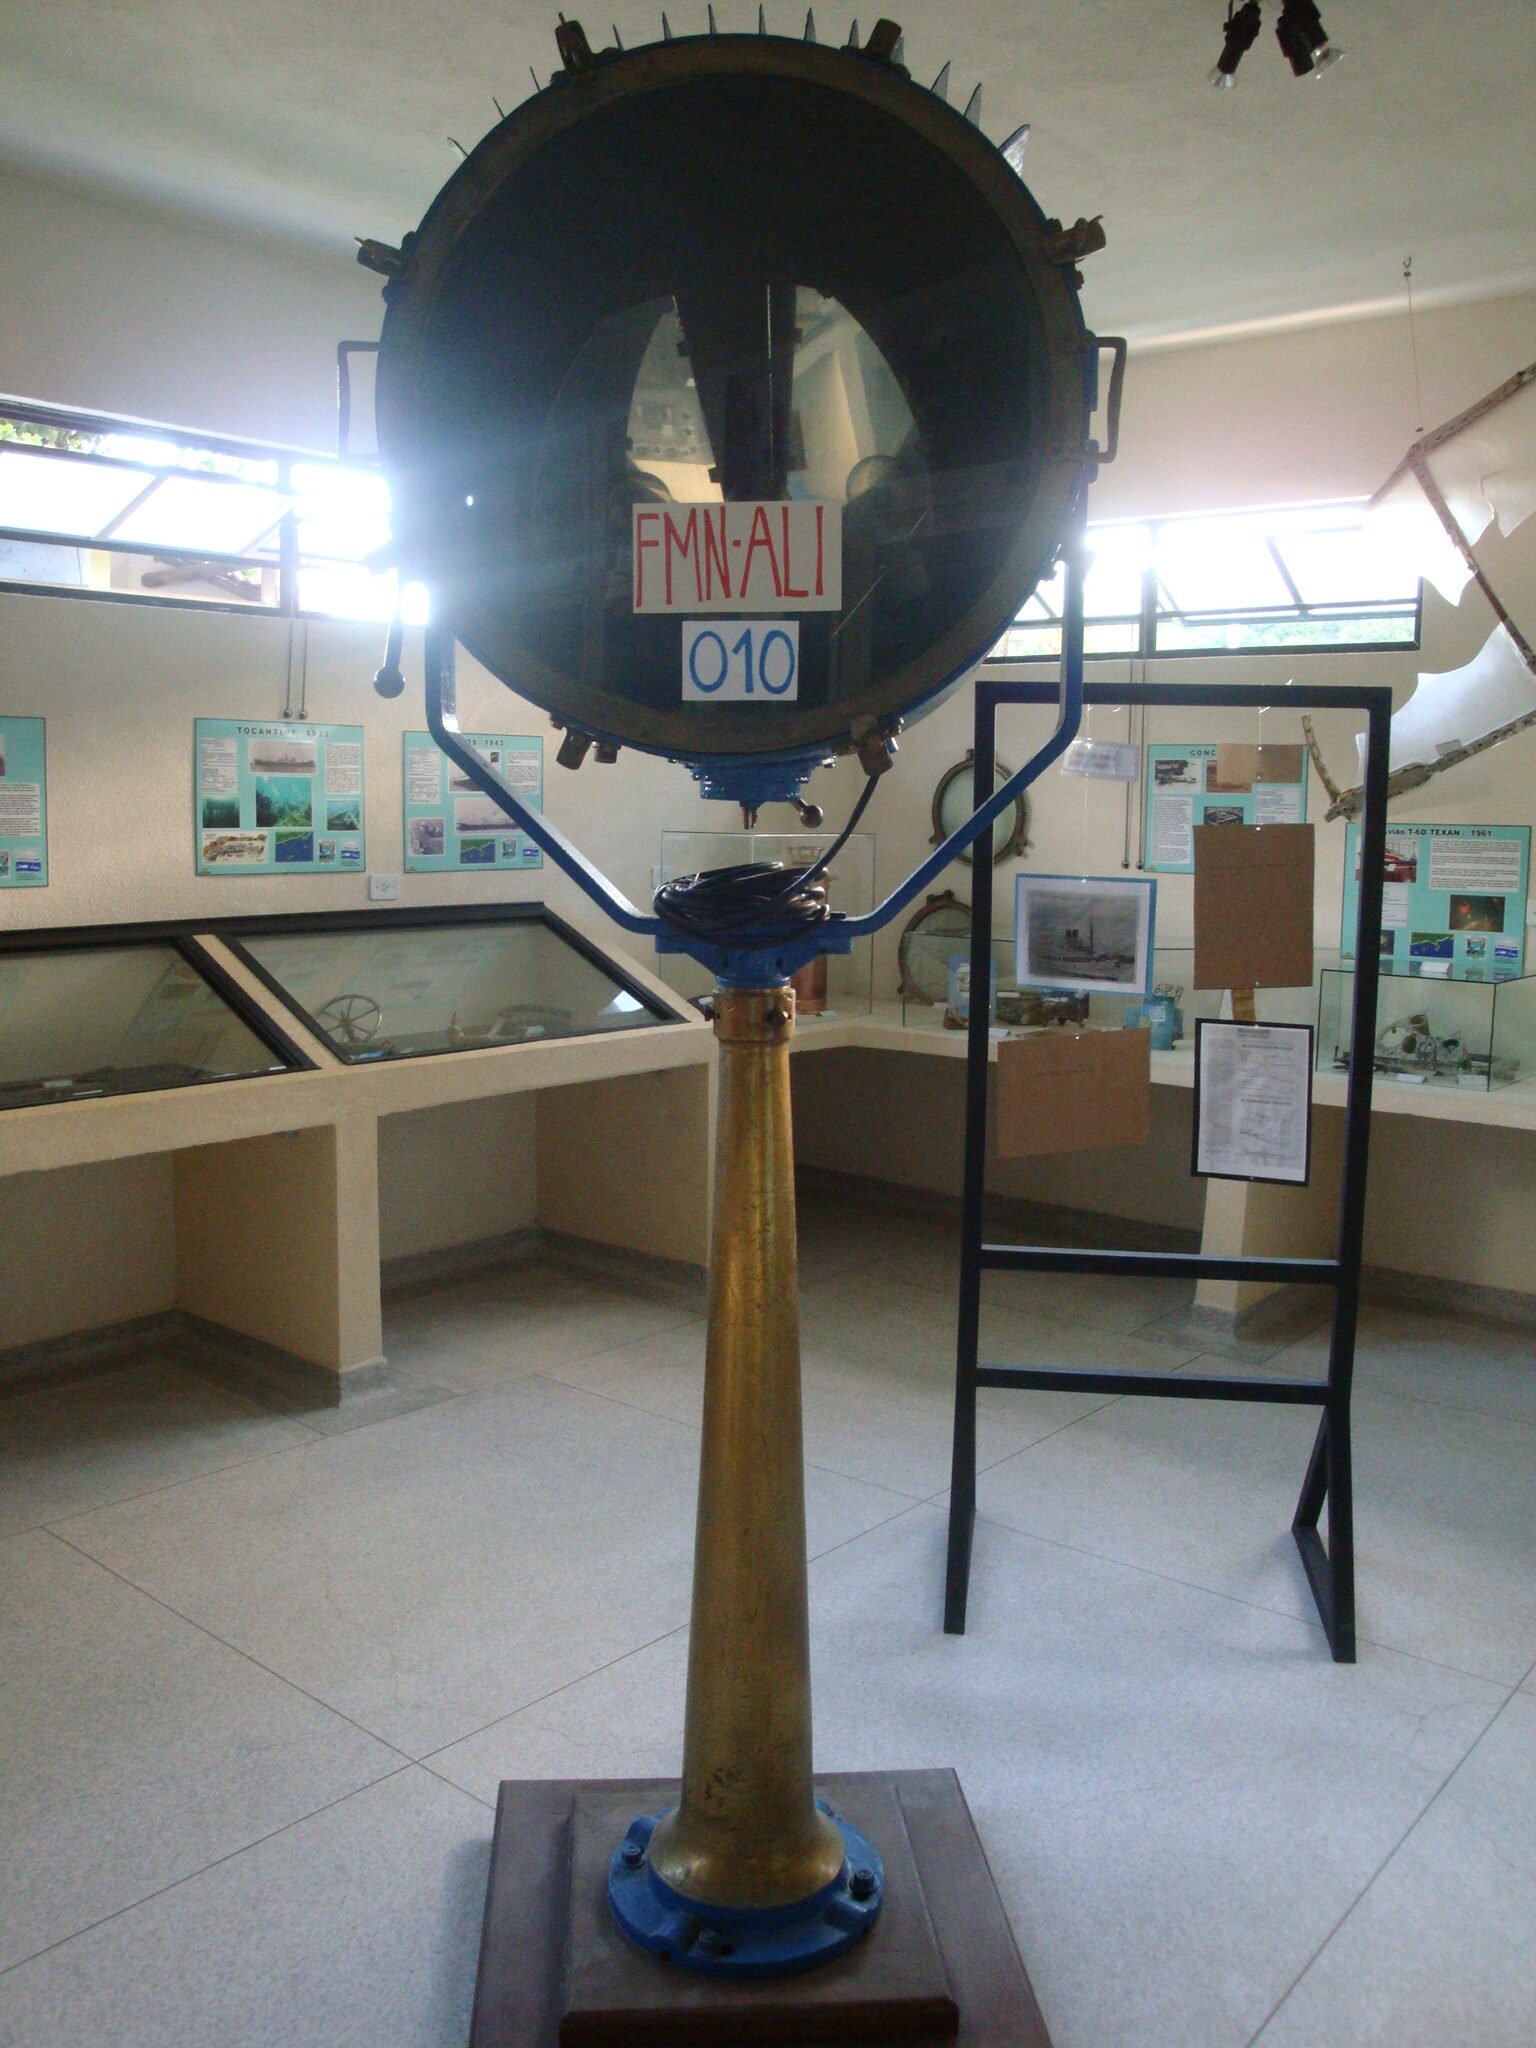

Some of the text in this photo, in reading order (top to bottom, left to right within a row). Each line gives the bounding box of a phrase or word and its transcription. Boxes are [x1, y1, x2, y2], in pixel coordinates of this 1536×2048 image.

[689, 628, 795, 694] 010
[1430, 828, 1460, 837] TEXAN
[1471, 829, 1492, 837] 1961
